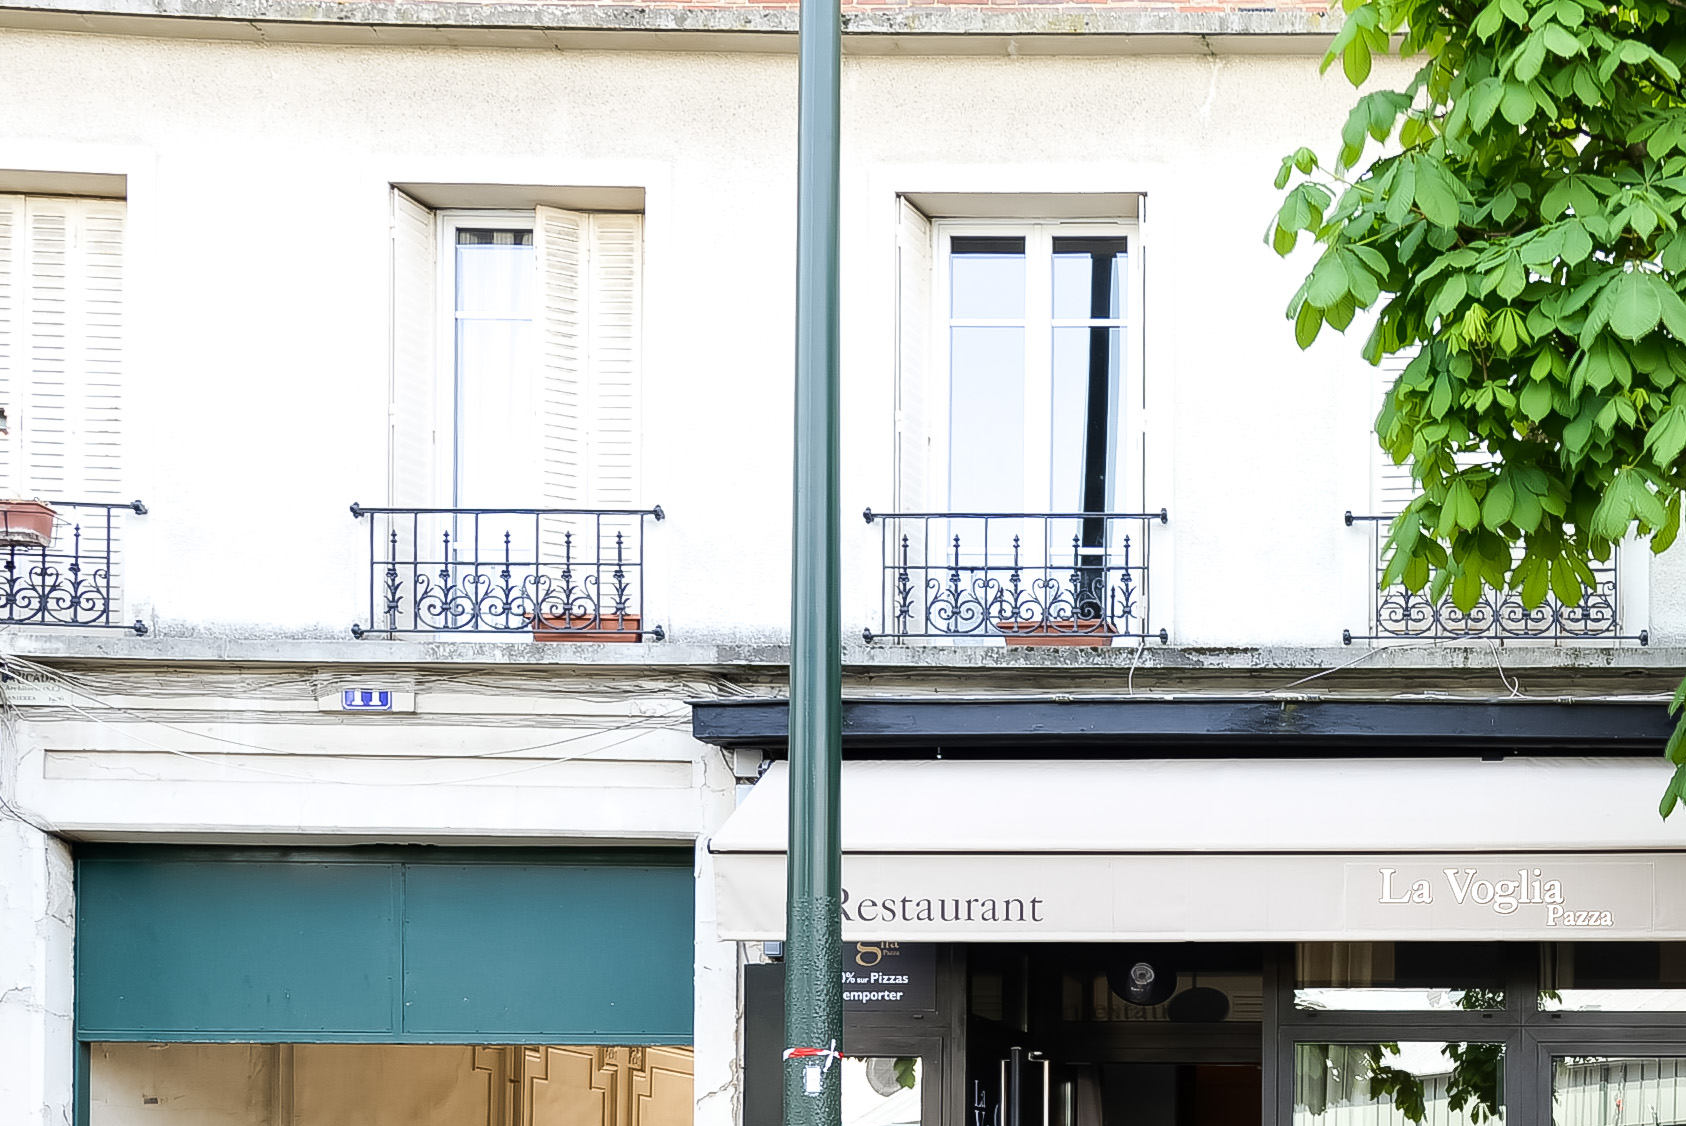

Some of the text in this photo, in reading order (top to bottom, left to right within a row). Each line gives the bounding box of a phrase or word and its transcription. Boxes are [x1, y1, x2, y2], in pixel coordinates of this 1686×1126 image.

[1378, 868, 1565, 915] La Voglia
[1545, 904, 1614, 926] Pazza
[870, 972, 909, 984] Pizzas
[842, 989, 904, 1004] emporter
